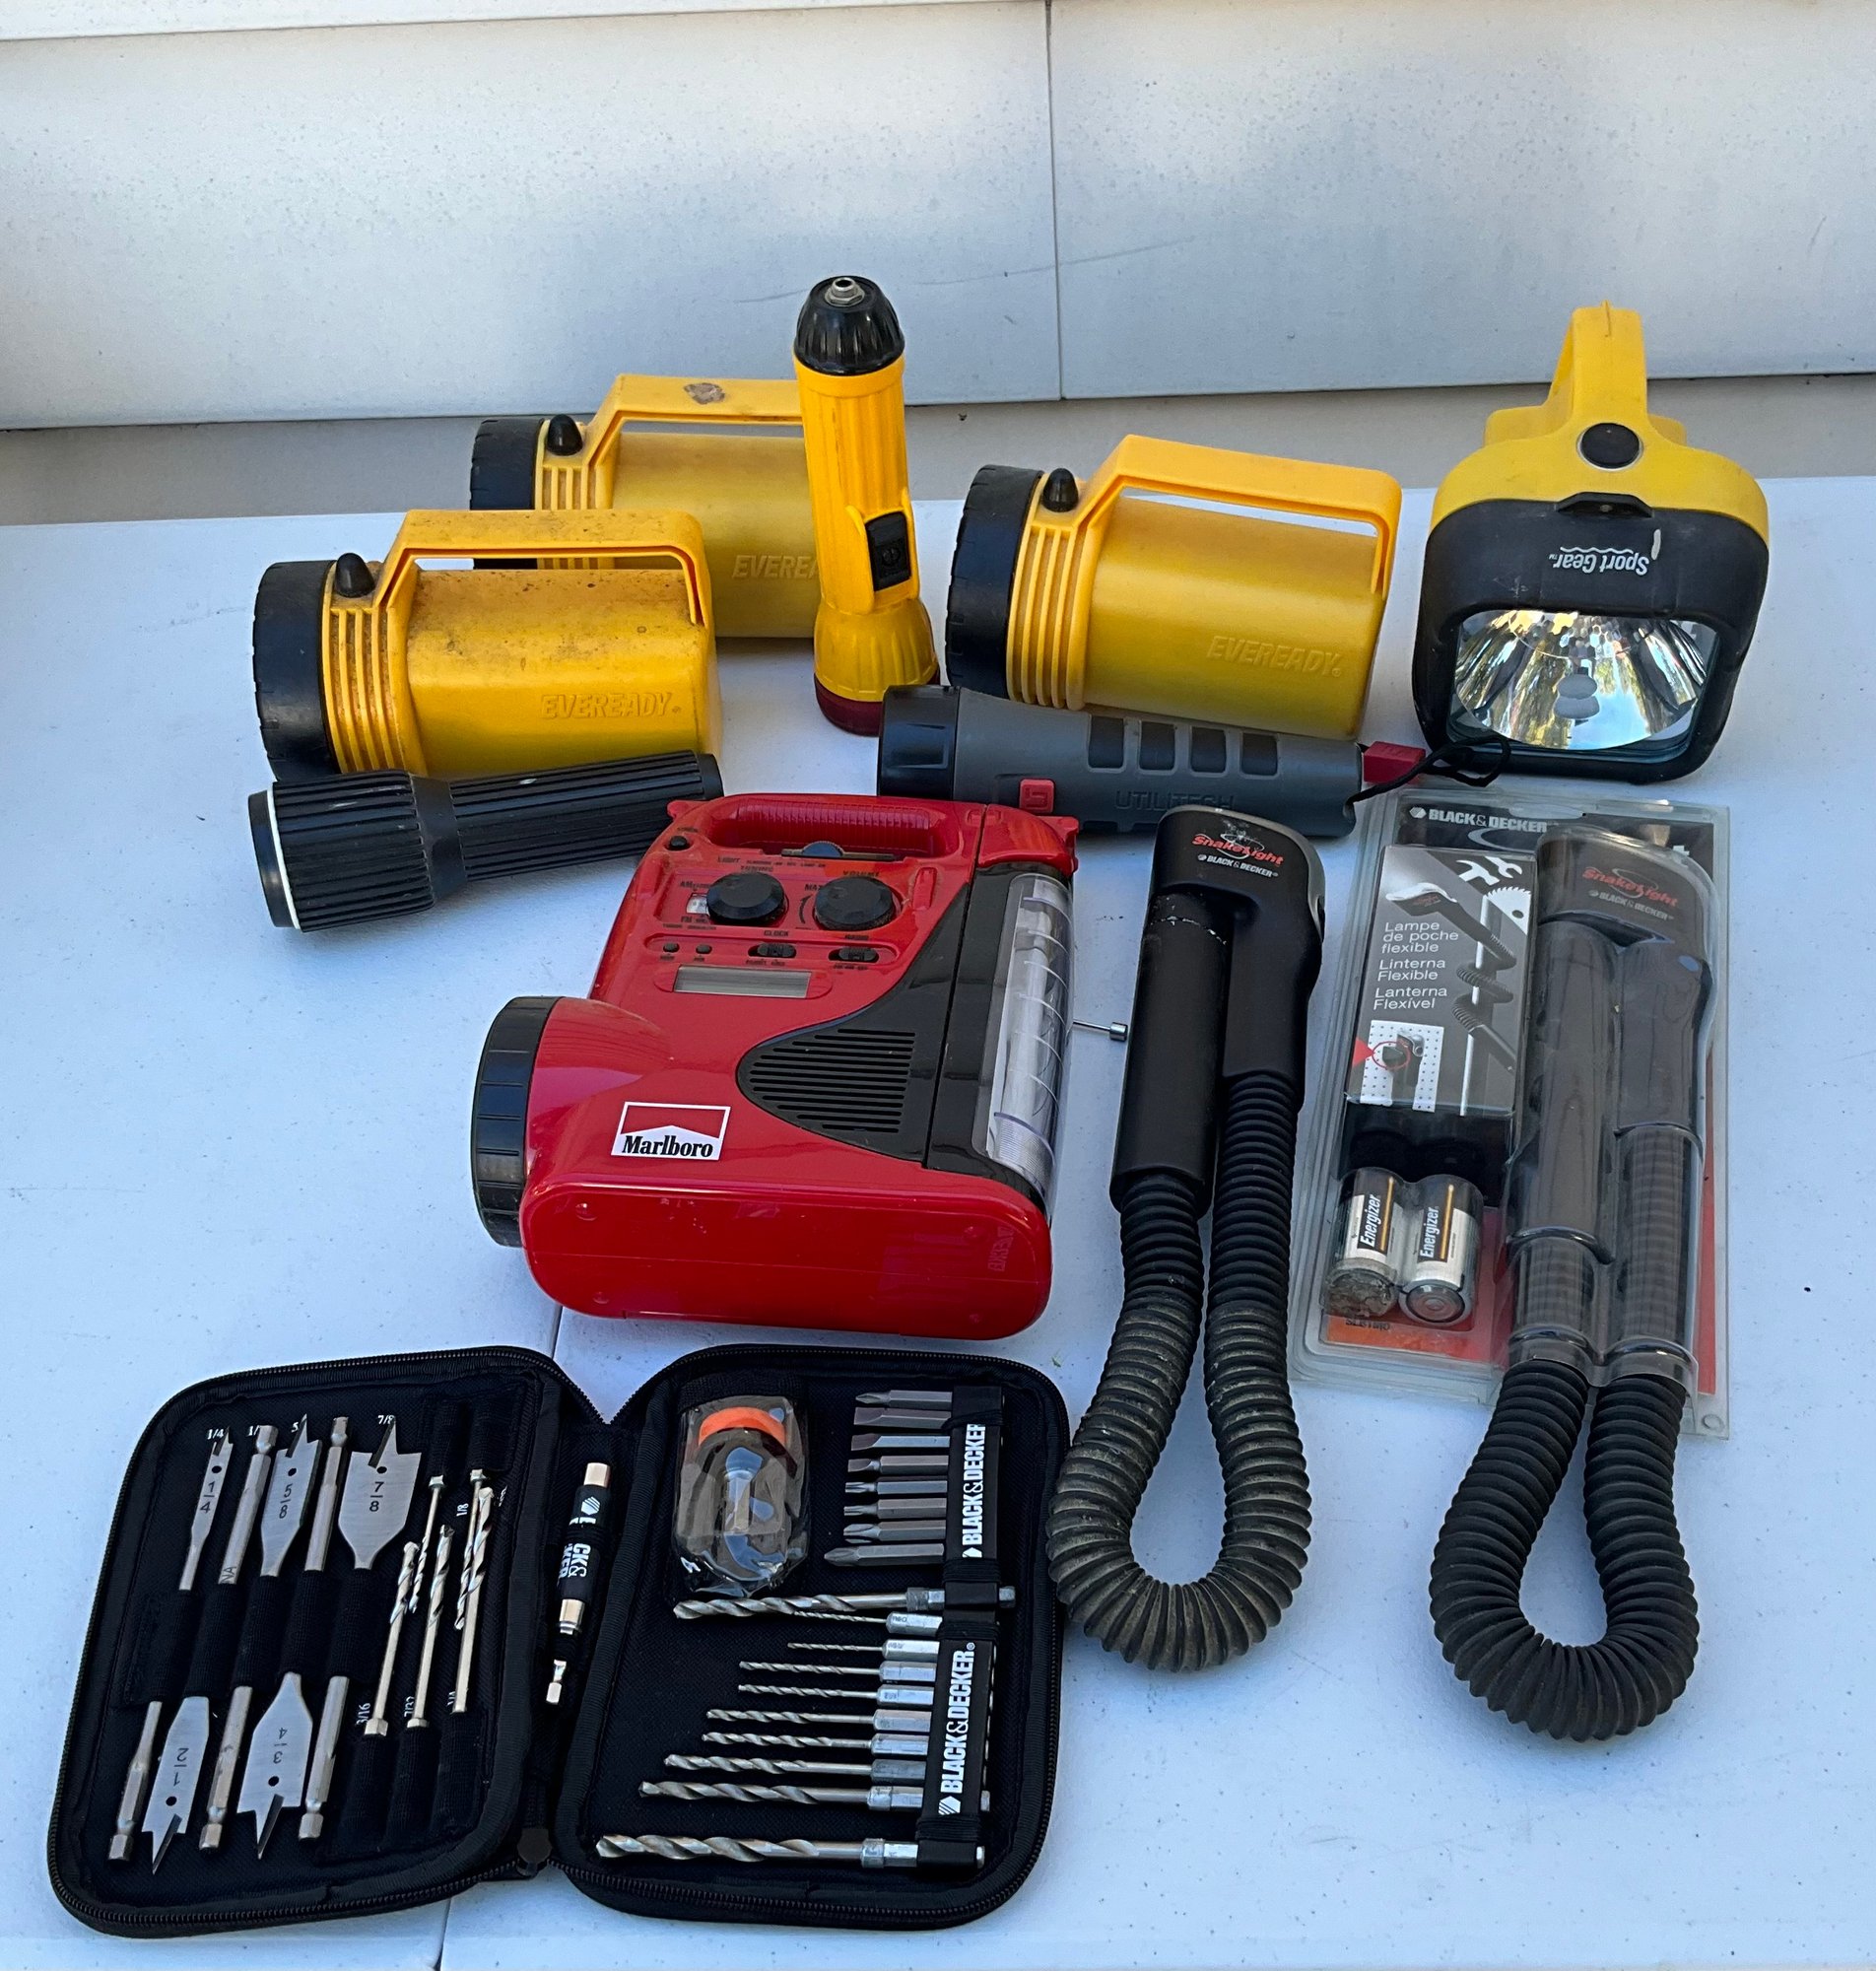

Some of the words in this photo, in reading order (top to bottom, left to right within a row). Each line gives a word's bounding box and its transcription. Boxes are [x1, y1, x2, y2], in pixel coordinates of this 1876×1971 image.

[732, 554, 820, 579] EVEREA
[1599, 553, 1649, 576] Sport
[1206, 635, 1341, 677] EVEREADY
[542, 692, 672, 719] EVEREADY
[1384, 921, 1440, 932] Lampe
[1382, 931, 1403, 942] de
[1409, 930, 1459, 943] poche
[1381, 942, 1440, 954] flexible
[1379, 959, 1445, 970] Linterna
[1377, 970, 1439, 982] Flexible
[1374, 986, 1447, 998] Lanterna
[1374, 997, 1436, 1010] Flexível
[622, 1135, 713, 1157] Marlboro
[1360, 1194, 1381, 1248] Energizer
[1420, 1207, 1440, 1258] Energizer
